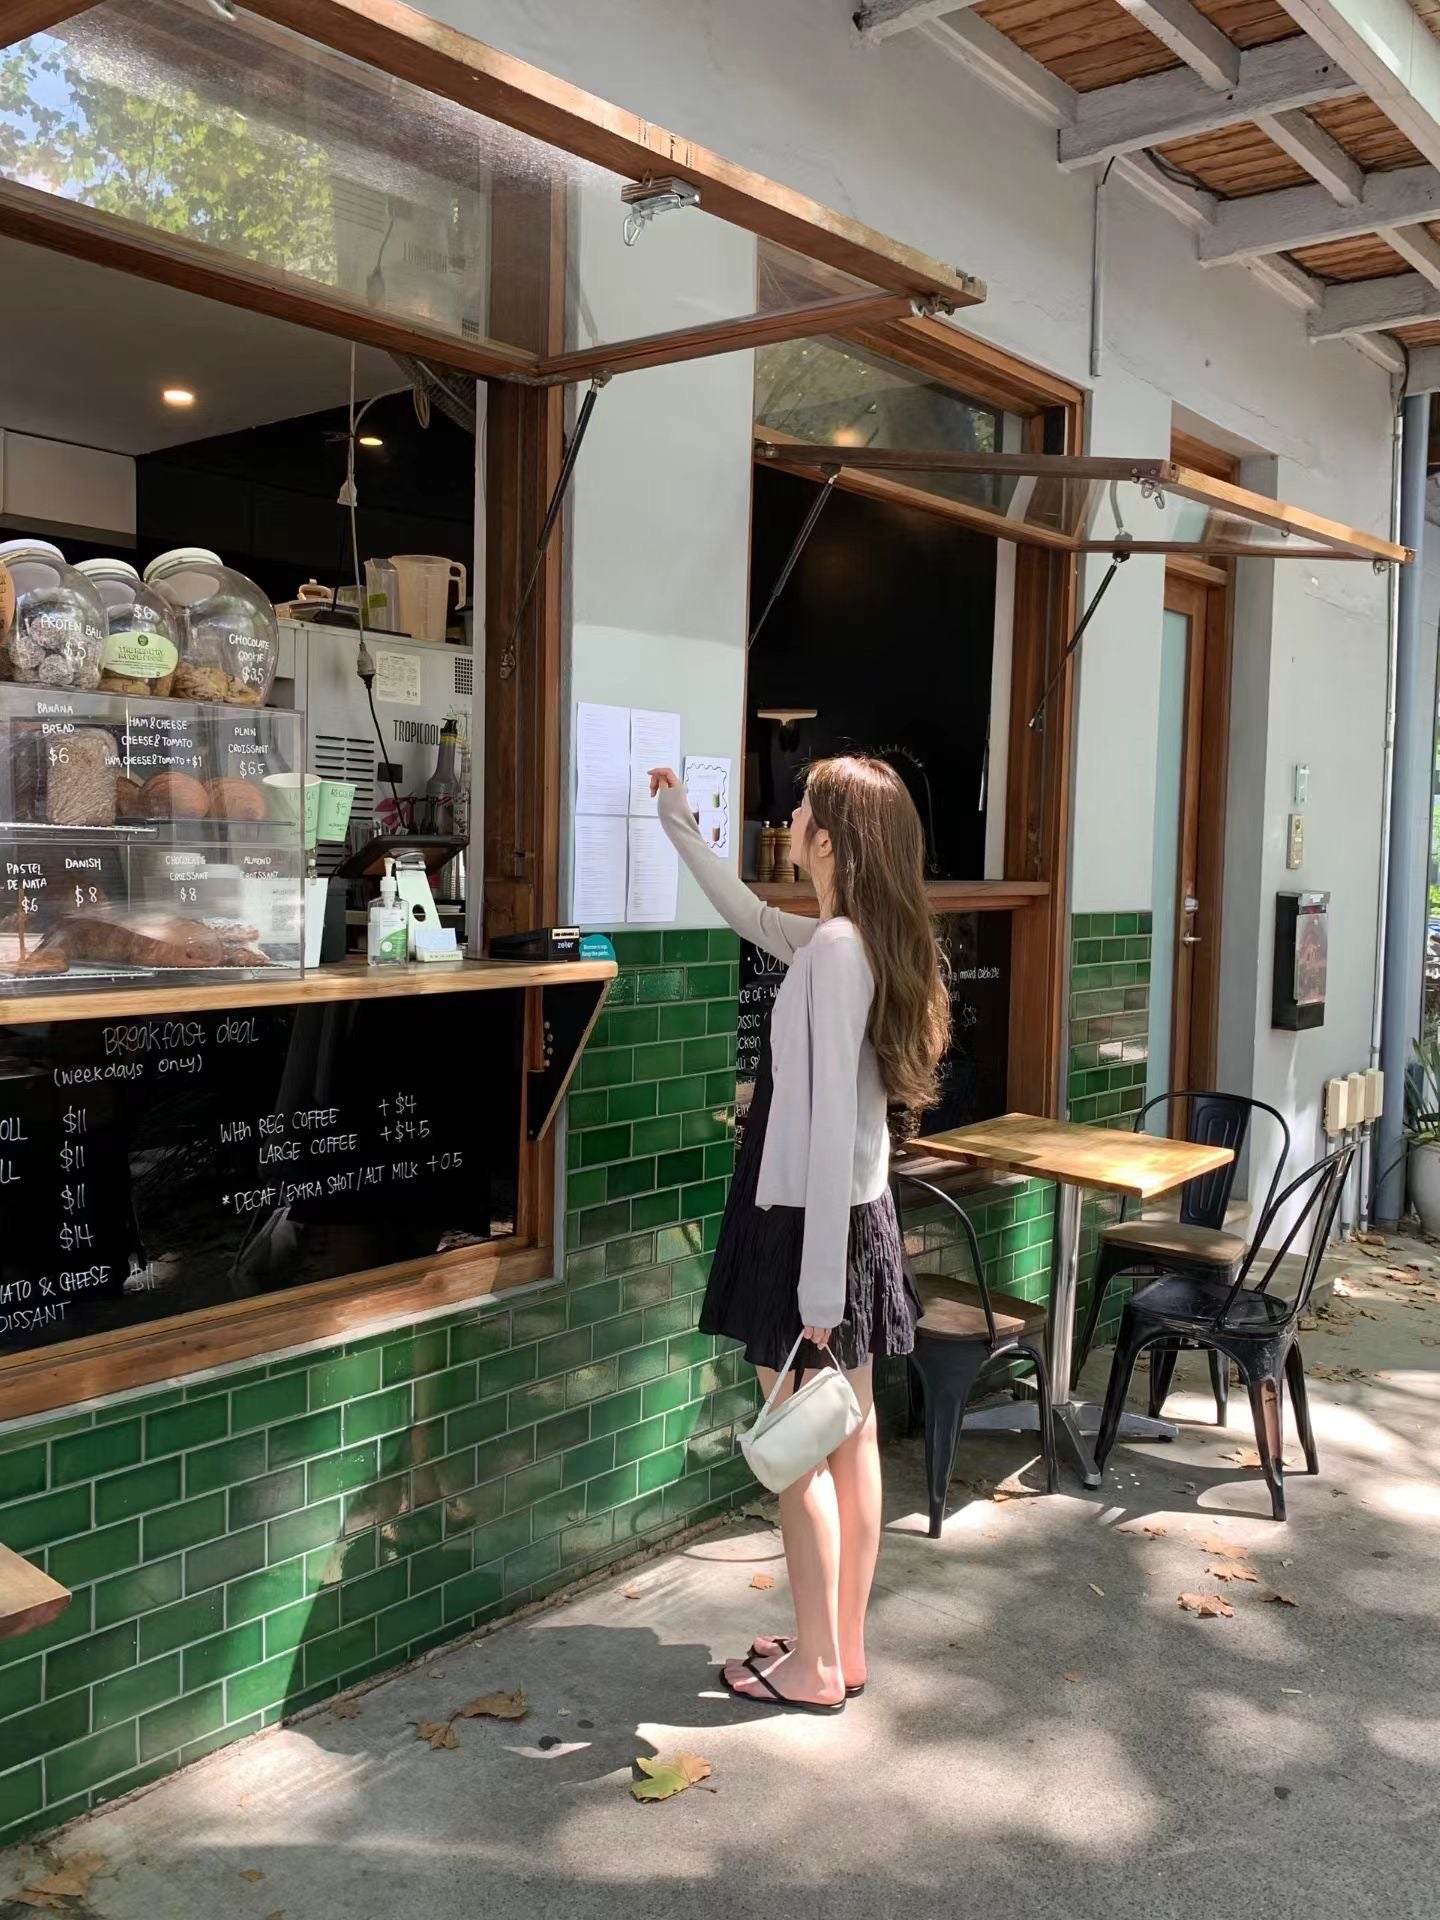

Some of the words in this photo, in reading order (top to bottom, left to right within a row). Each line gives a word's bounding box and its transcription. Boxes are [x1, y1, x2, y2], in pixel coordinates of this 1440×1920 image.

[85, 625, 103, 640] BALL
[229, 633, 270, 650] CHOCOLATE
[37, 702, 74, 714] BANANA
[42, 723, 75, 734] BREAD
[234, 727, 257, 736] PLAIN
[393, 719, 440, 745] TROPICOOL
[162, 737, 193, 748] TOMATO
[228, 744, 269, 754] CROISSANT
[48, 747, 69, 766] $6
[65, 858, 101, 870] DANISH
[243, 856, 272, 865] ALMOND
[6, 863, 43, 875] PASTEL
[7, 879, 20, 890] DE
[22, 878, 47, 890] NATA
[21, 898, 39, 913] $6
[63, 1105, 87, 1133] $11
[258, 1113, 284, 1138] REG
[292, 1108, 340, 1129] COFFEE
[60, 1141, 85, 1172] $11
[259, 1142, 302, 1164] LARGE
[310, 1134, 357, 1155] COFFEE
[392, 1162, 419, 1180] MILK
[61, 1183, 86, 1215] $11
[59, 1222, 94, 1251] $14
[0, 1279, 32, 1304] ATO
[38, 1276, 56, 1296] &
[60, 1266, 111, 1292] CHEESE
